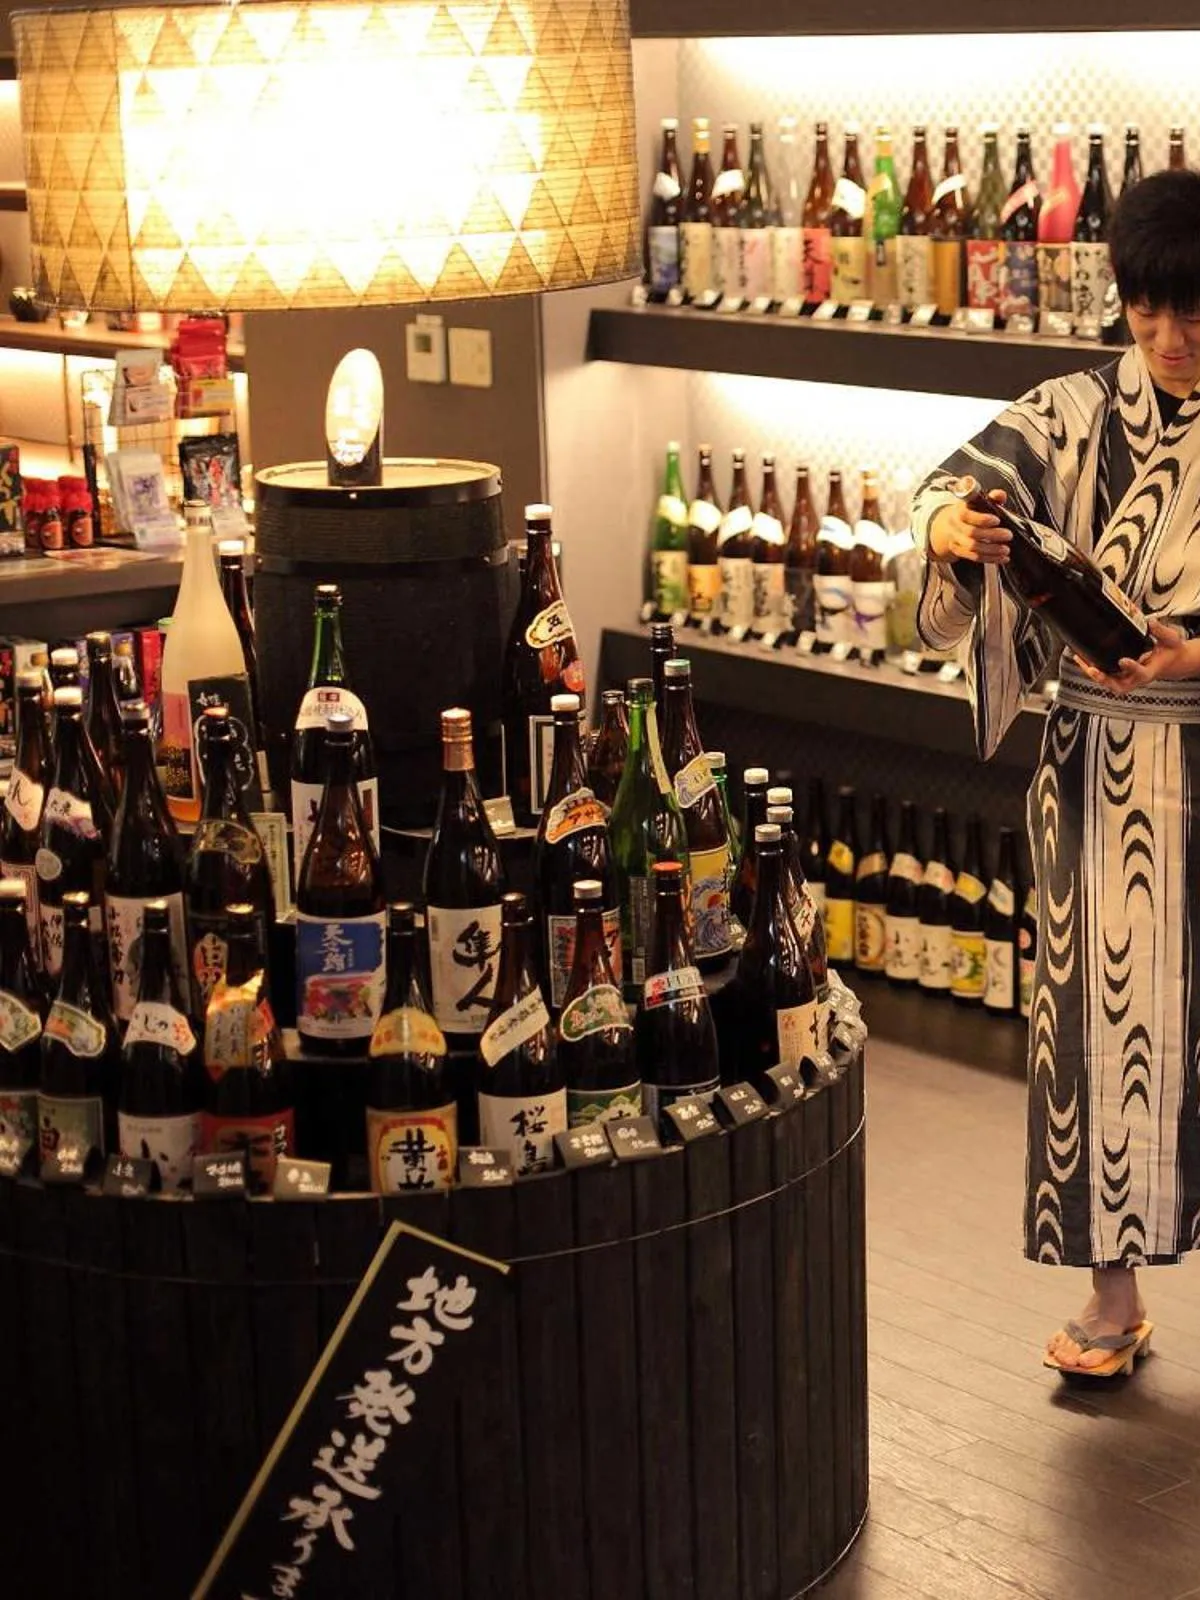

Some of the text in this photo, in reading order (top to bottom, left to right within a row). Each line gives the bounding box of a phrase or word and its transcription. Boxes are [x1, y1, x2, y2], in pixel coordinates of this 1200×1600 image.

[453, 920, 502, 1012] 隼人
[510, 1105, 549, 1177] 桜島
[241, 1265, 477, 1600] 地方発送承りま
